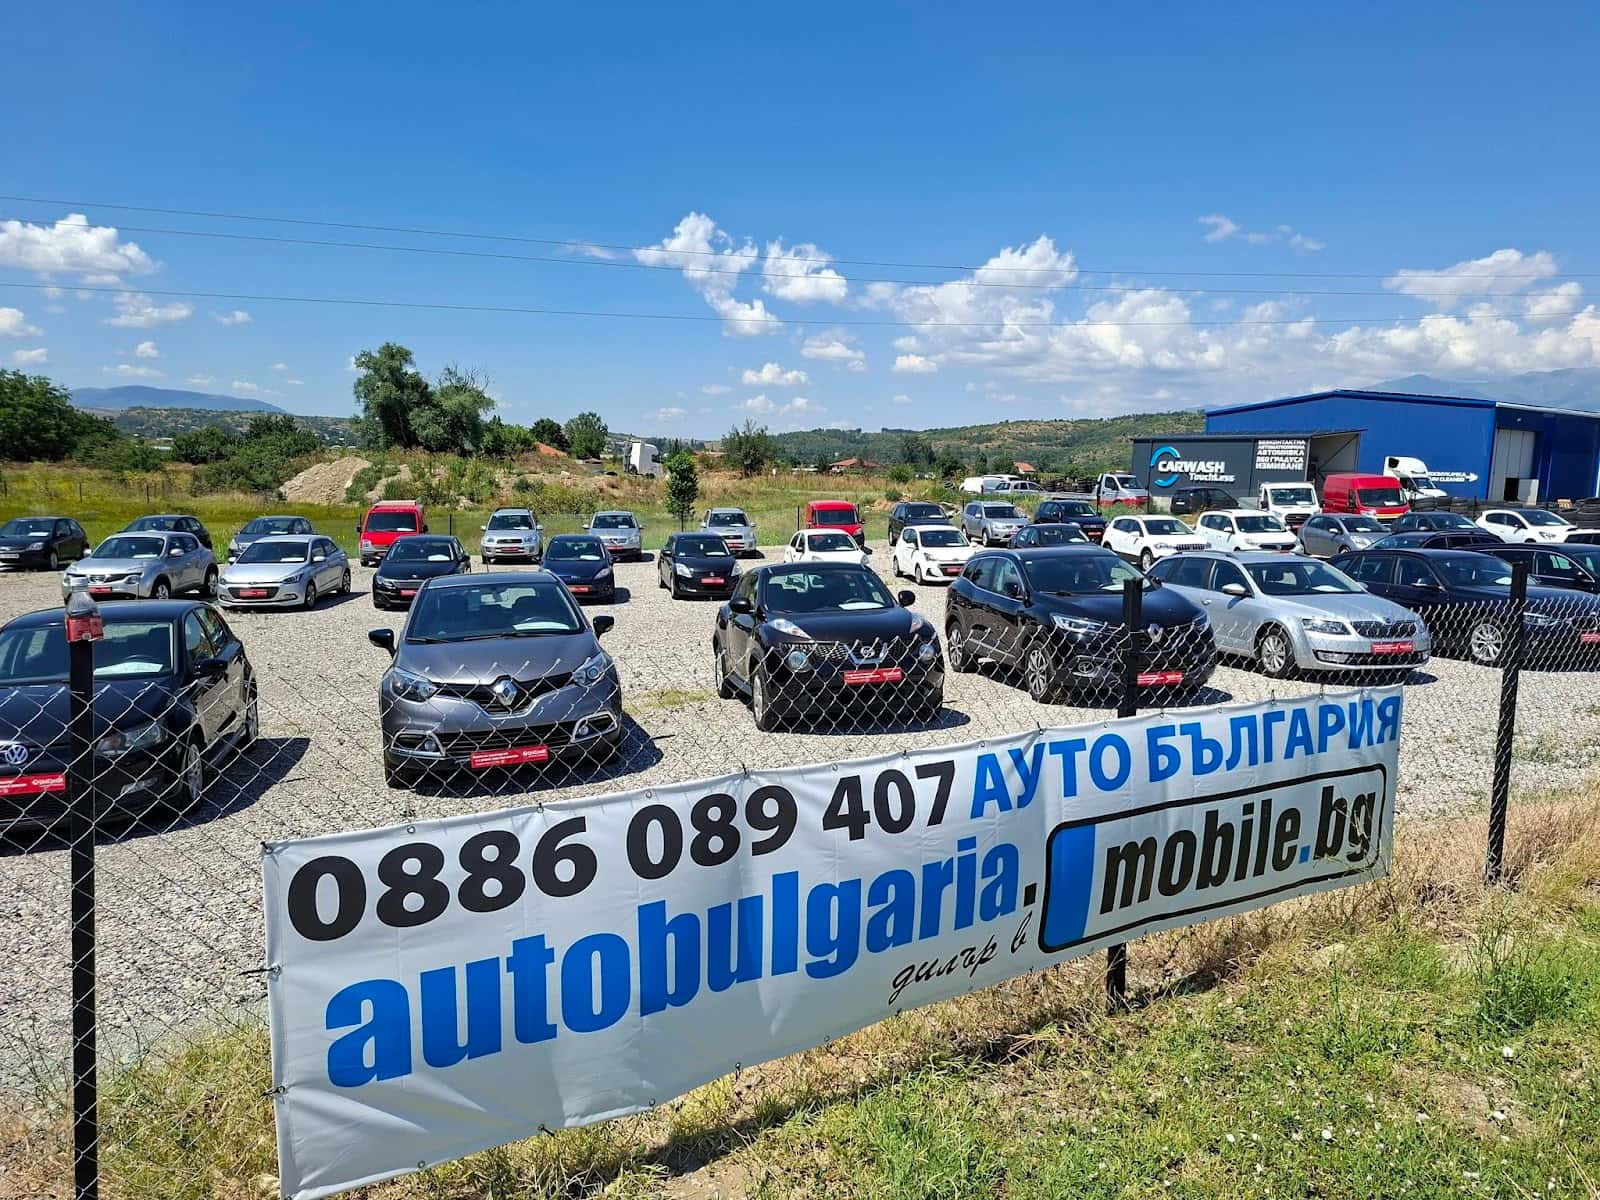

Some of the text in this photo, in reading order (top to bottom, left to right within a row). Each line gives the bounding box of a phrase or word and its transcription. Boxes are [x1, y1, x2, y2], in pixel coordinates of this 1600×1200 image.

[1158, 460, 1225, 473] CARWASH
[287, 696, 1400, 942] 0886 089 407 АУТО БЪЛГАРИЯ
[1100, 786, 1377, 914] mobile.bg
[888, 934, 999, 1005] дилър
